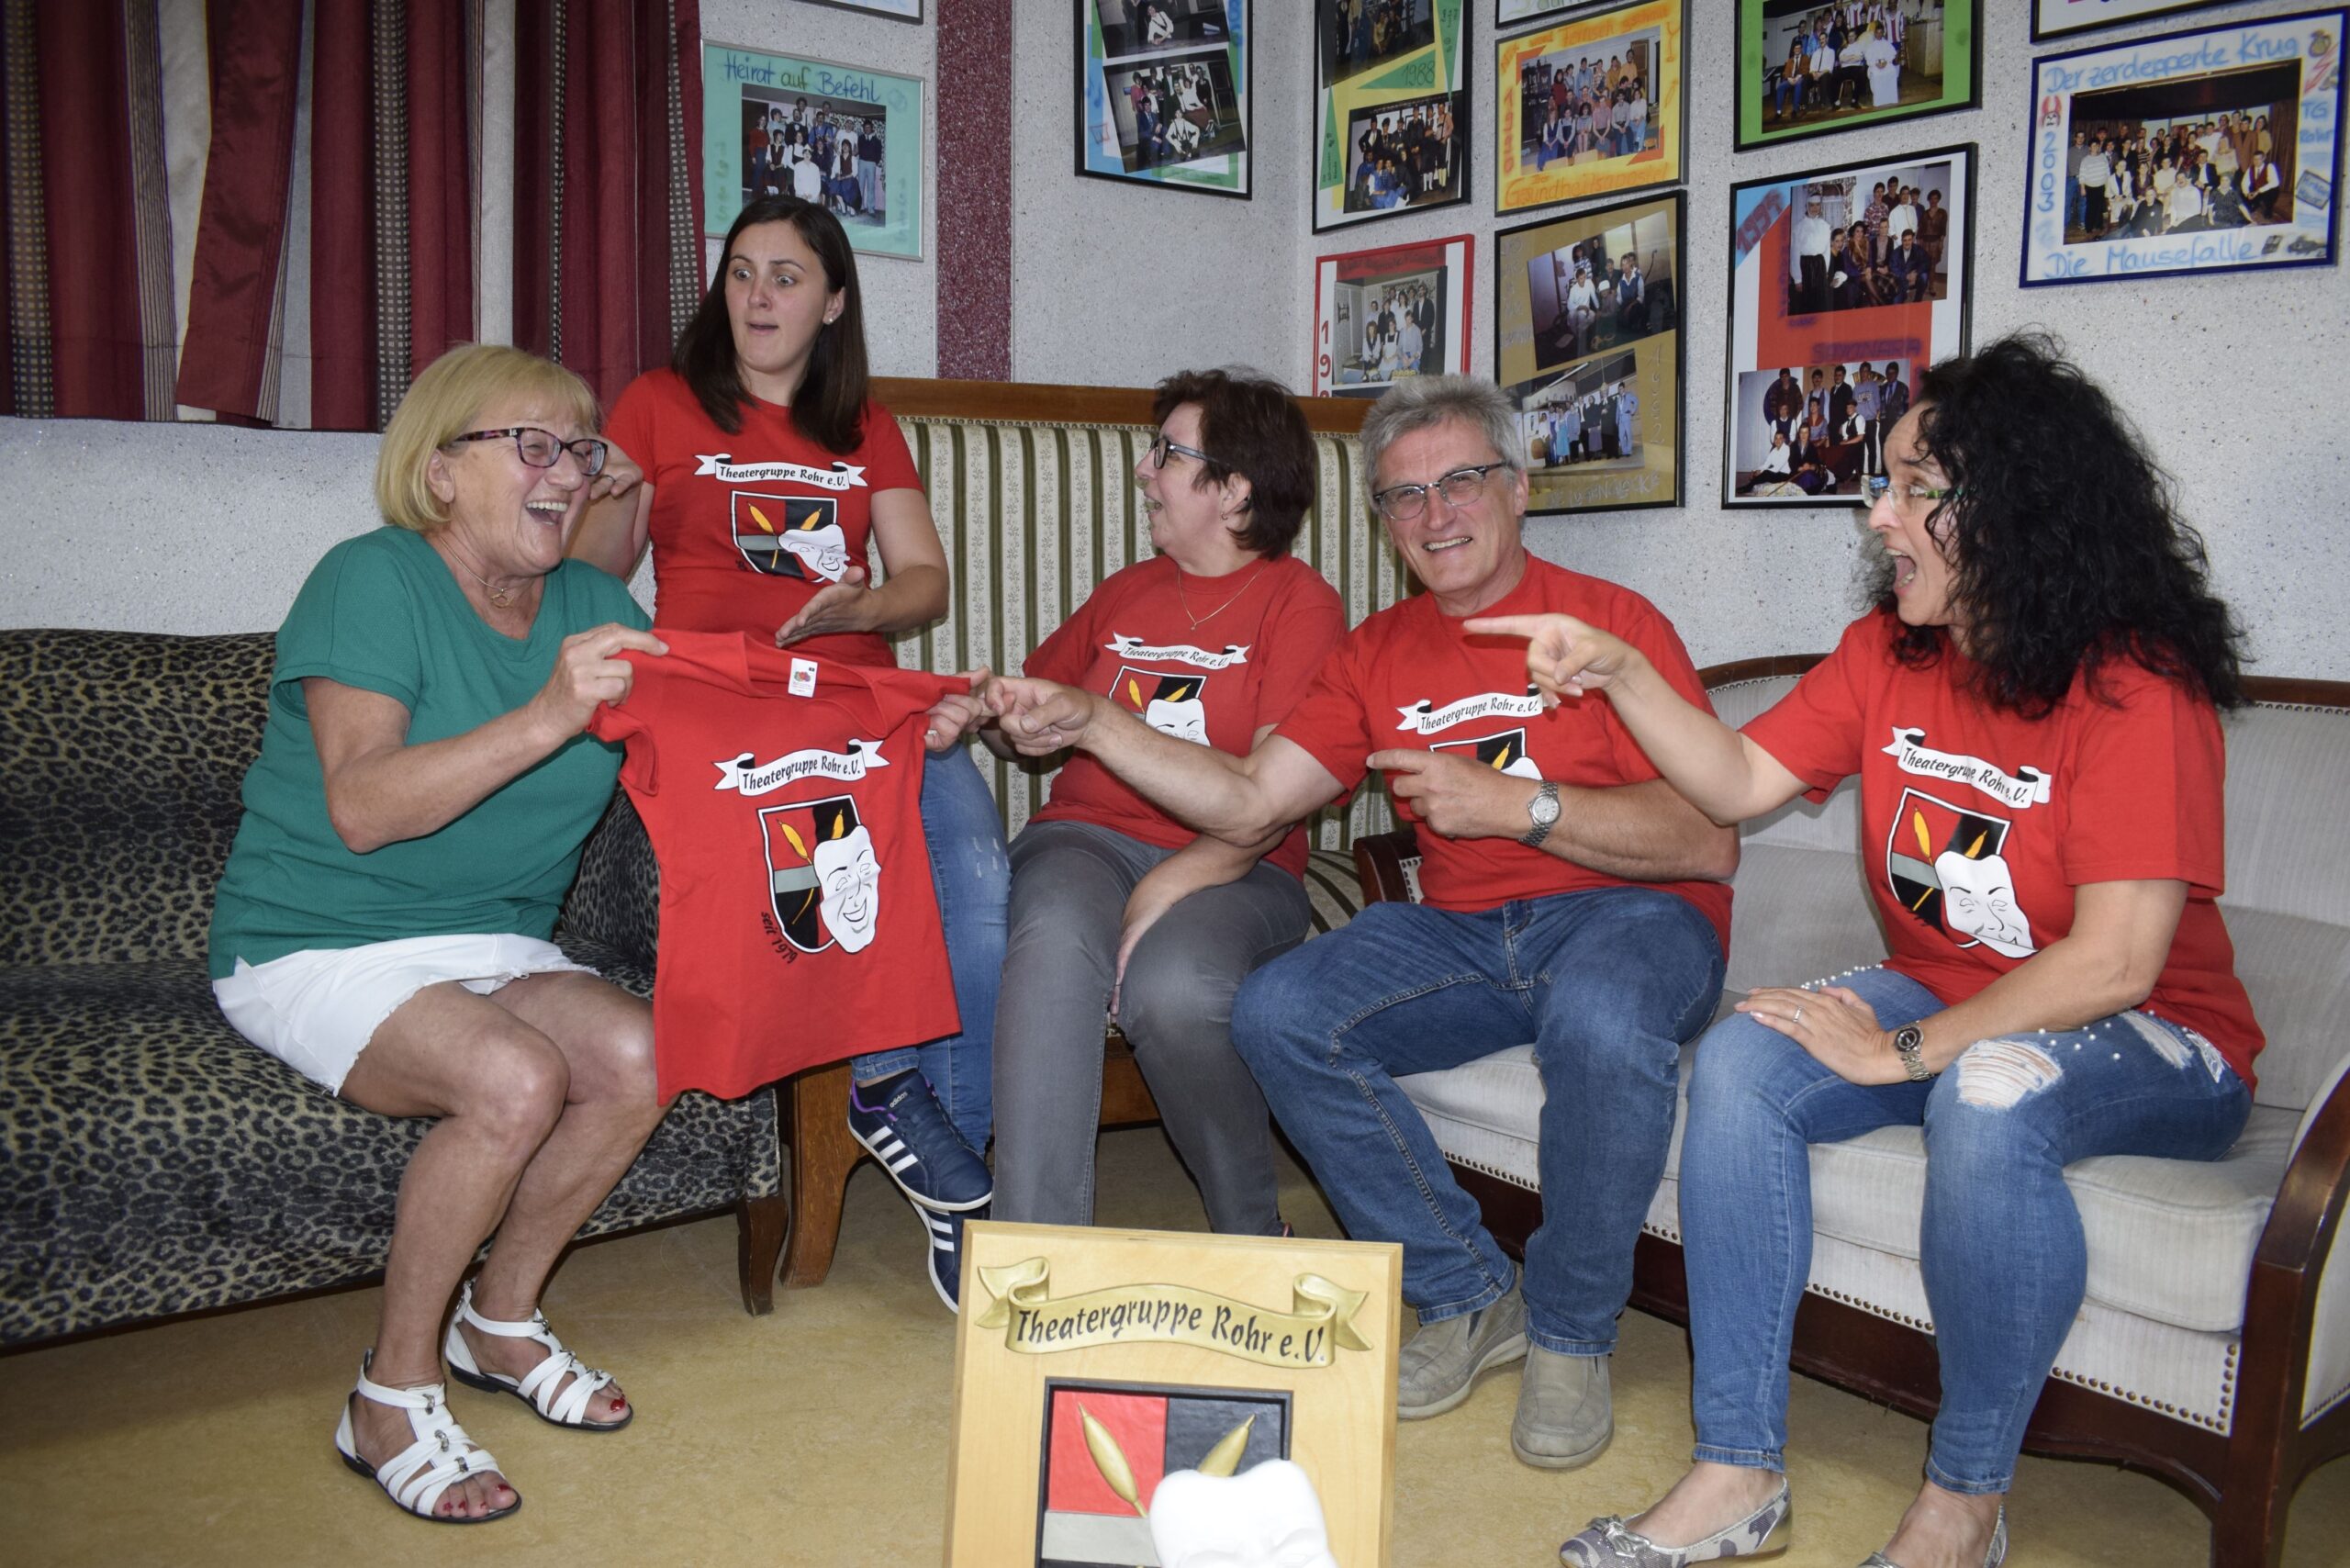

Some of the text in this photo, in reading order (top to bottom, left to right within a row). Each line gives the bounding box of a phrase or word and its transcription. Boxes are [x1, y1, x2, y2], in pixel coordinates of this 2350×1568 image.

[723, 51, 881, 102] Heirat auf Befehl
[1403, 60, 1435, 86] 1988
[2044, 31, 2300, 94] Der zerdepperte Krug
[2301, 100, 2328, 119] TG
[2037, 131, 2056, 212] 2003
[2044, 234, 2256, 279] Die Mausefalle
[720, 465, 846, 487] Theatergruppe Rohr e.V.
[1125, 646, 1226, 666] Theatergruppe Rohr e.V.
[1421, 697, 1539, 730] Theatergruppe Rohr e.V.
[743, 755, 861, 790] Theatergruppe Rohr e.V.
[761, 911, 799, 965] seit 1979
[890, 1092, 908, 1108] adidas
[1016, 1298, 1325, 1362] Theatergruppe Rohr e.V.
